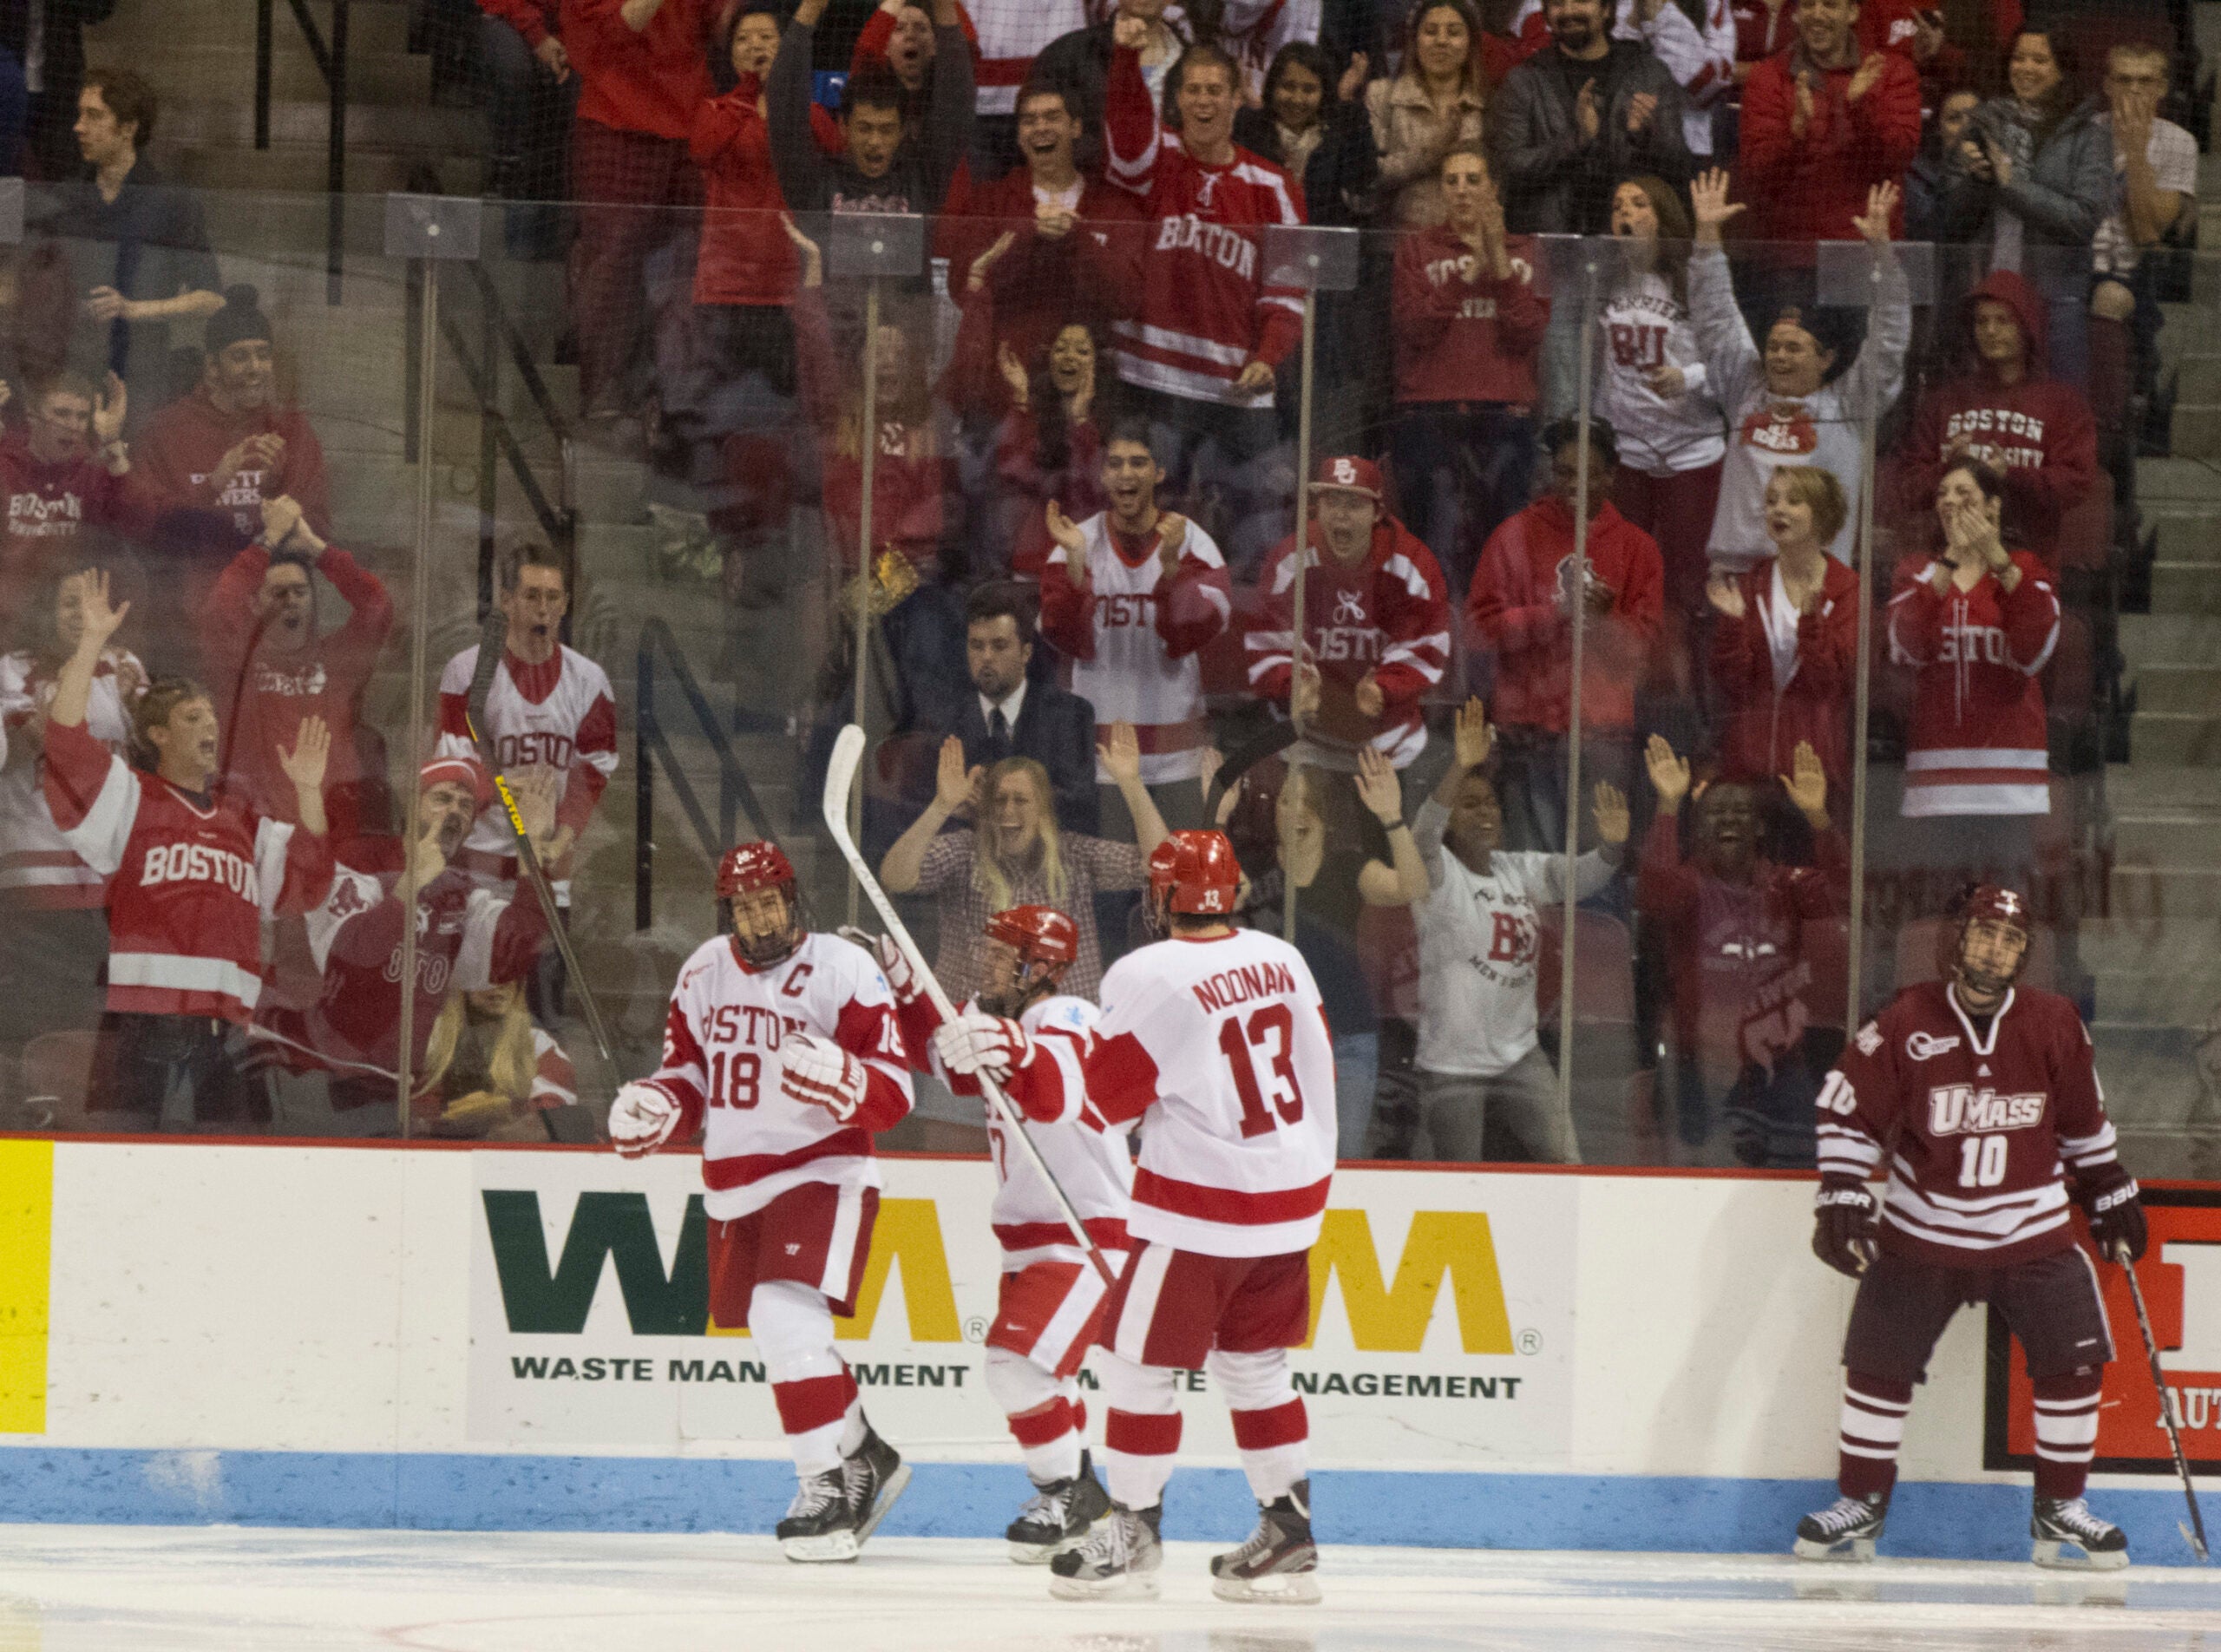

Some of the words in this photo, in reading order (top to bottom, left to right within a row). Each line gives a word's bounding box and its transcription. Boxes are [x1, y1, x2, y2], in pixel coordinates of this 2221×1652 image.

[1947, 408, 2044, 443] BOSTON
[498, 732, 573, 770] OSTO
[495, 775, 526, 836] EASTON
[139, 842, 259, 908] BOSTON
[1204, 889, 1220, 908] 13
[782, 963, 814, 998] C
[1191, 962, 1296, 1014] NOONAN
[710, 1051, 761, 1110] 18
[1218, 1002, 1304, 1140] 13
[1814, 1070, 1857, 1116] 10
[1958, 1135, 2008, 1189] 10
[511, 1356, 653, 1381] WASTE
[1292, 1372, 1522, 1400] NAGEMENT
